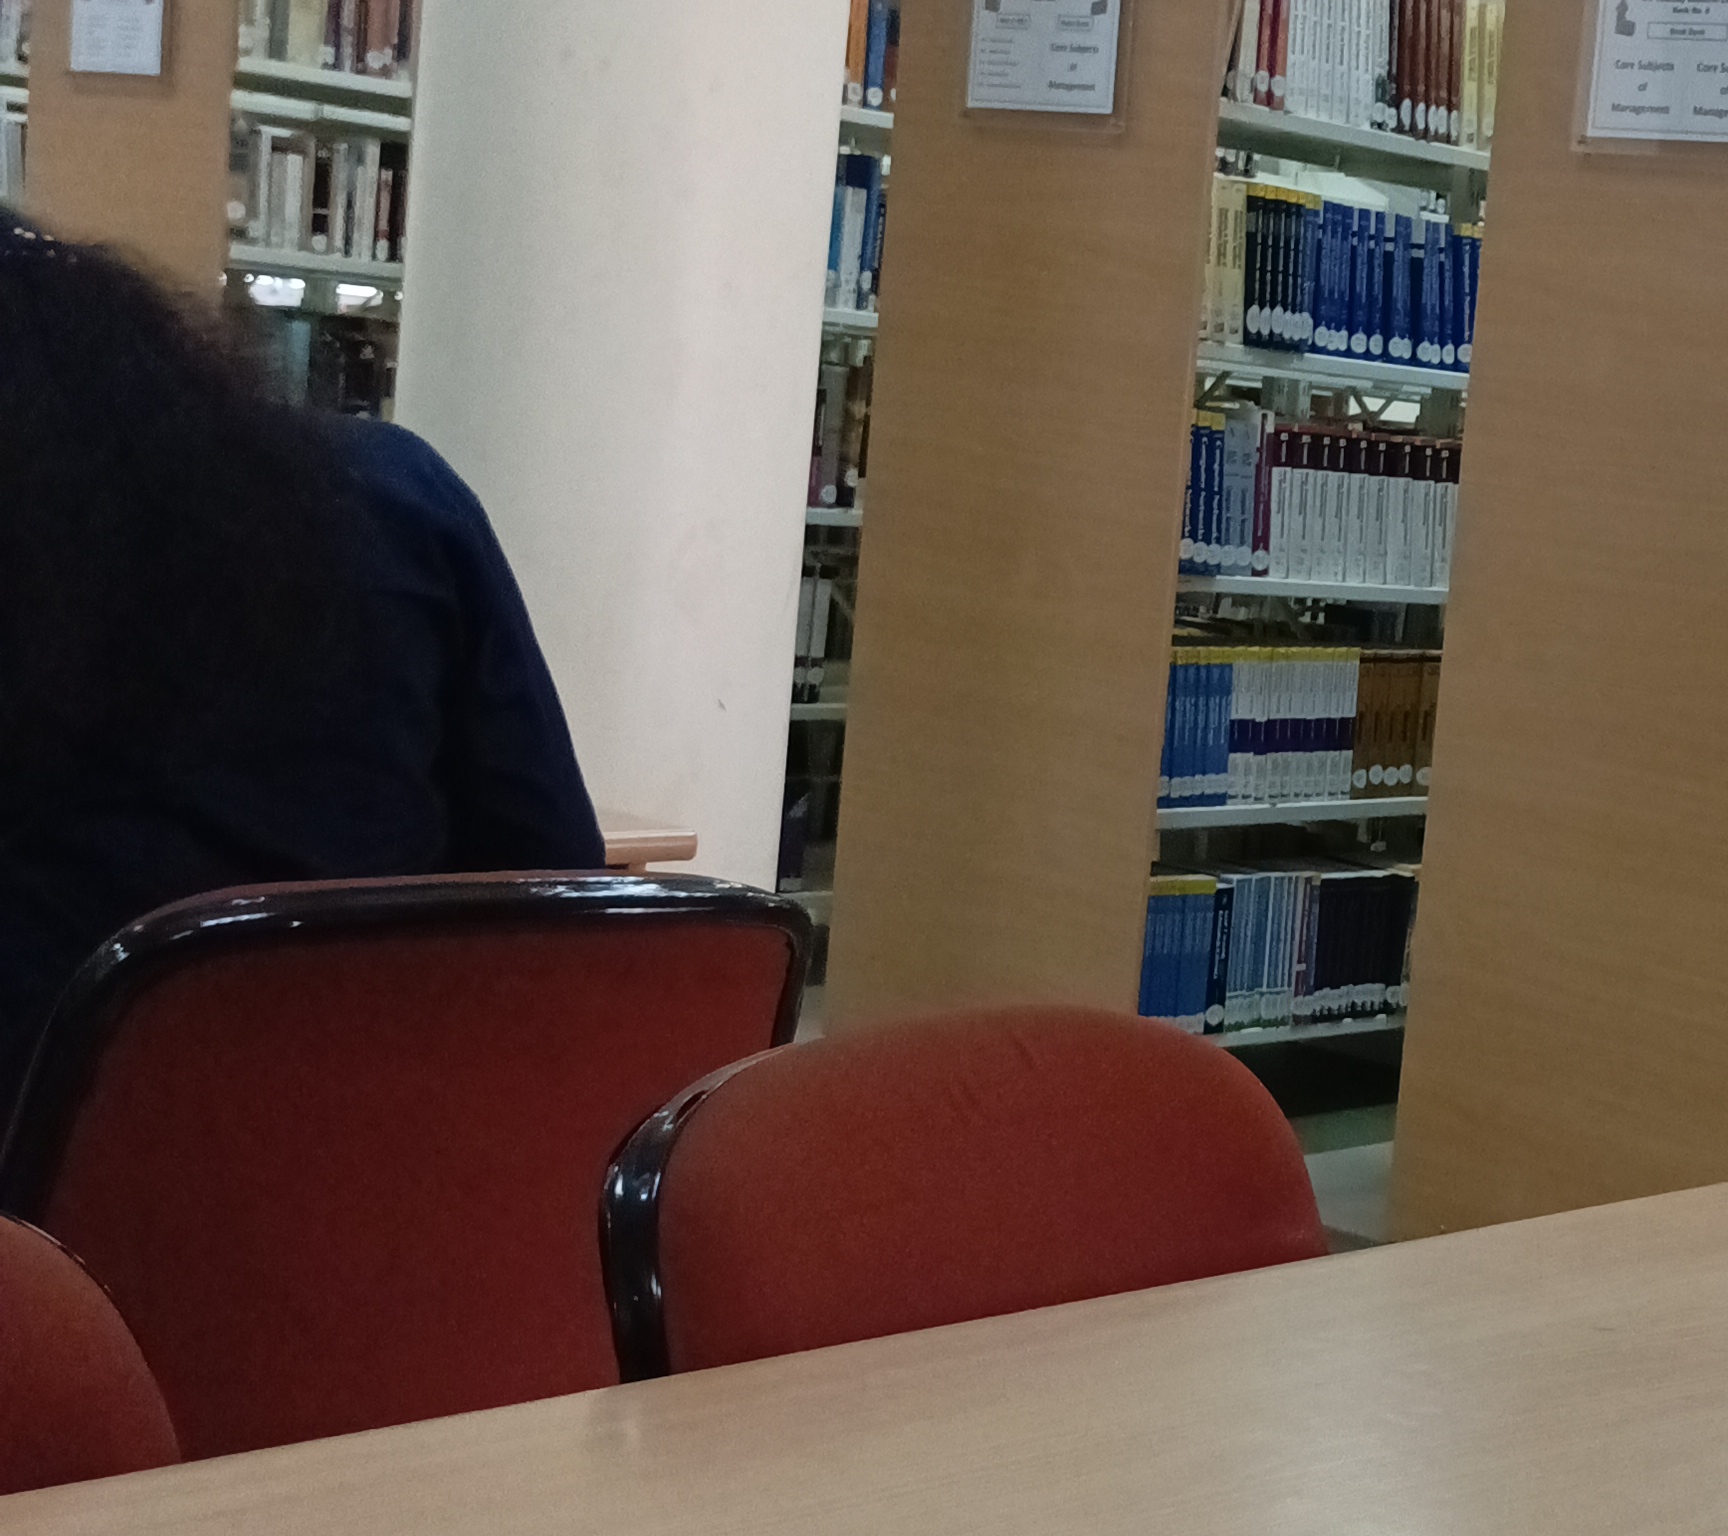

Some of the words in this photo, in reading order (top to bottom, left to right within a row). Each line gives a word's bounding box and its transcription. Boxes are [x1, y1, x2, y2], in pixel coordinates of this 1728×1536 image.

[1615, 59, 1636, 70] Core
[1637, 60, 1675, 73] Subjects
[1696, 62, 1718, 74] Core
[1636, 81, 1649, 93] of
[1611, 102, 1671, 116] Management
